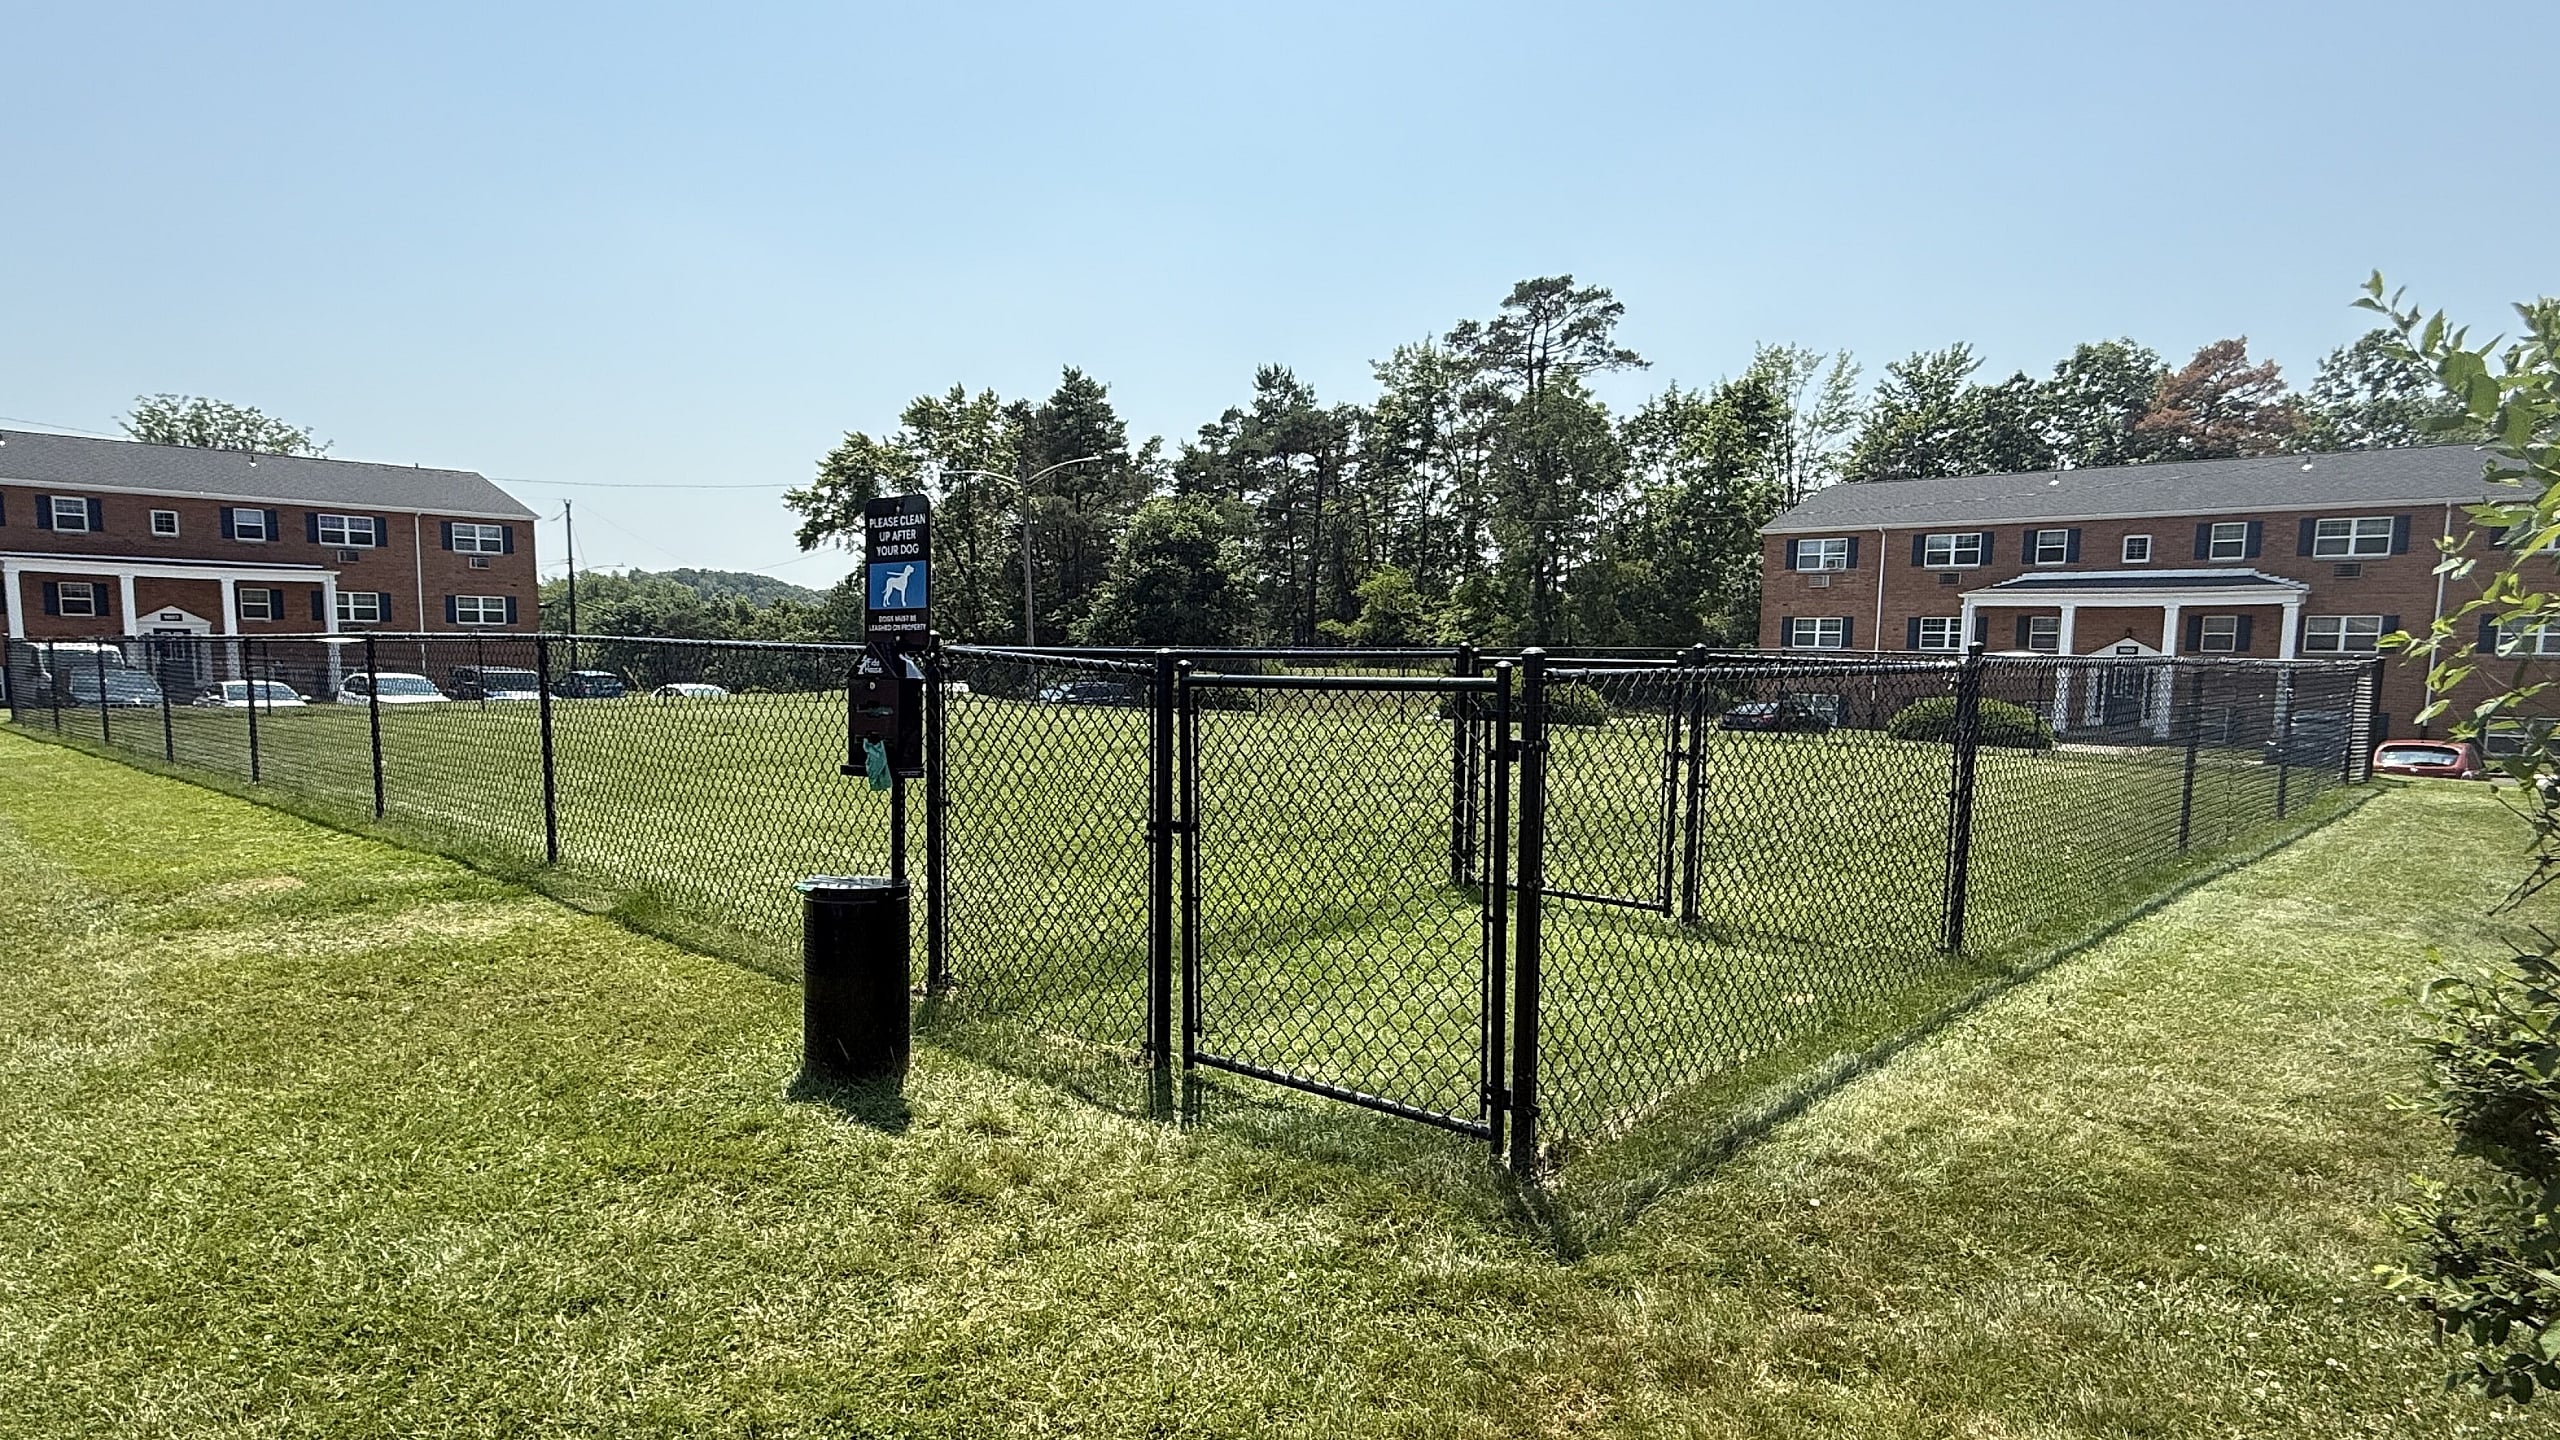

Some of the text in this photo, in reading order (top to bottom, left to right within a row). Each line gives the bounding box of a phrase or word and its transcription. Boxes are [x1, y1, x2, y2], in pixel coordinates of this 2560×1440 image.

[869, 513, 926, 529] PLEASE CLEAN
[879, 529, 916, 542] UP AFTER
[876, 543, 919, 557] YOUR DOG
[878, 614, 917, 623] DOGS MUST BE
[869, 624, 892, 632] LEASHED
[901, 623, 927, 631] PROPERTY
